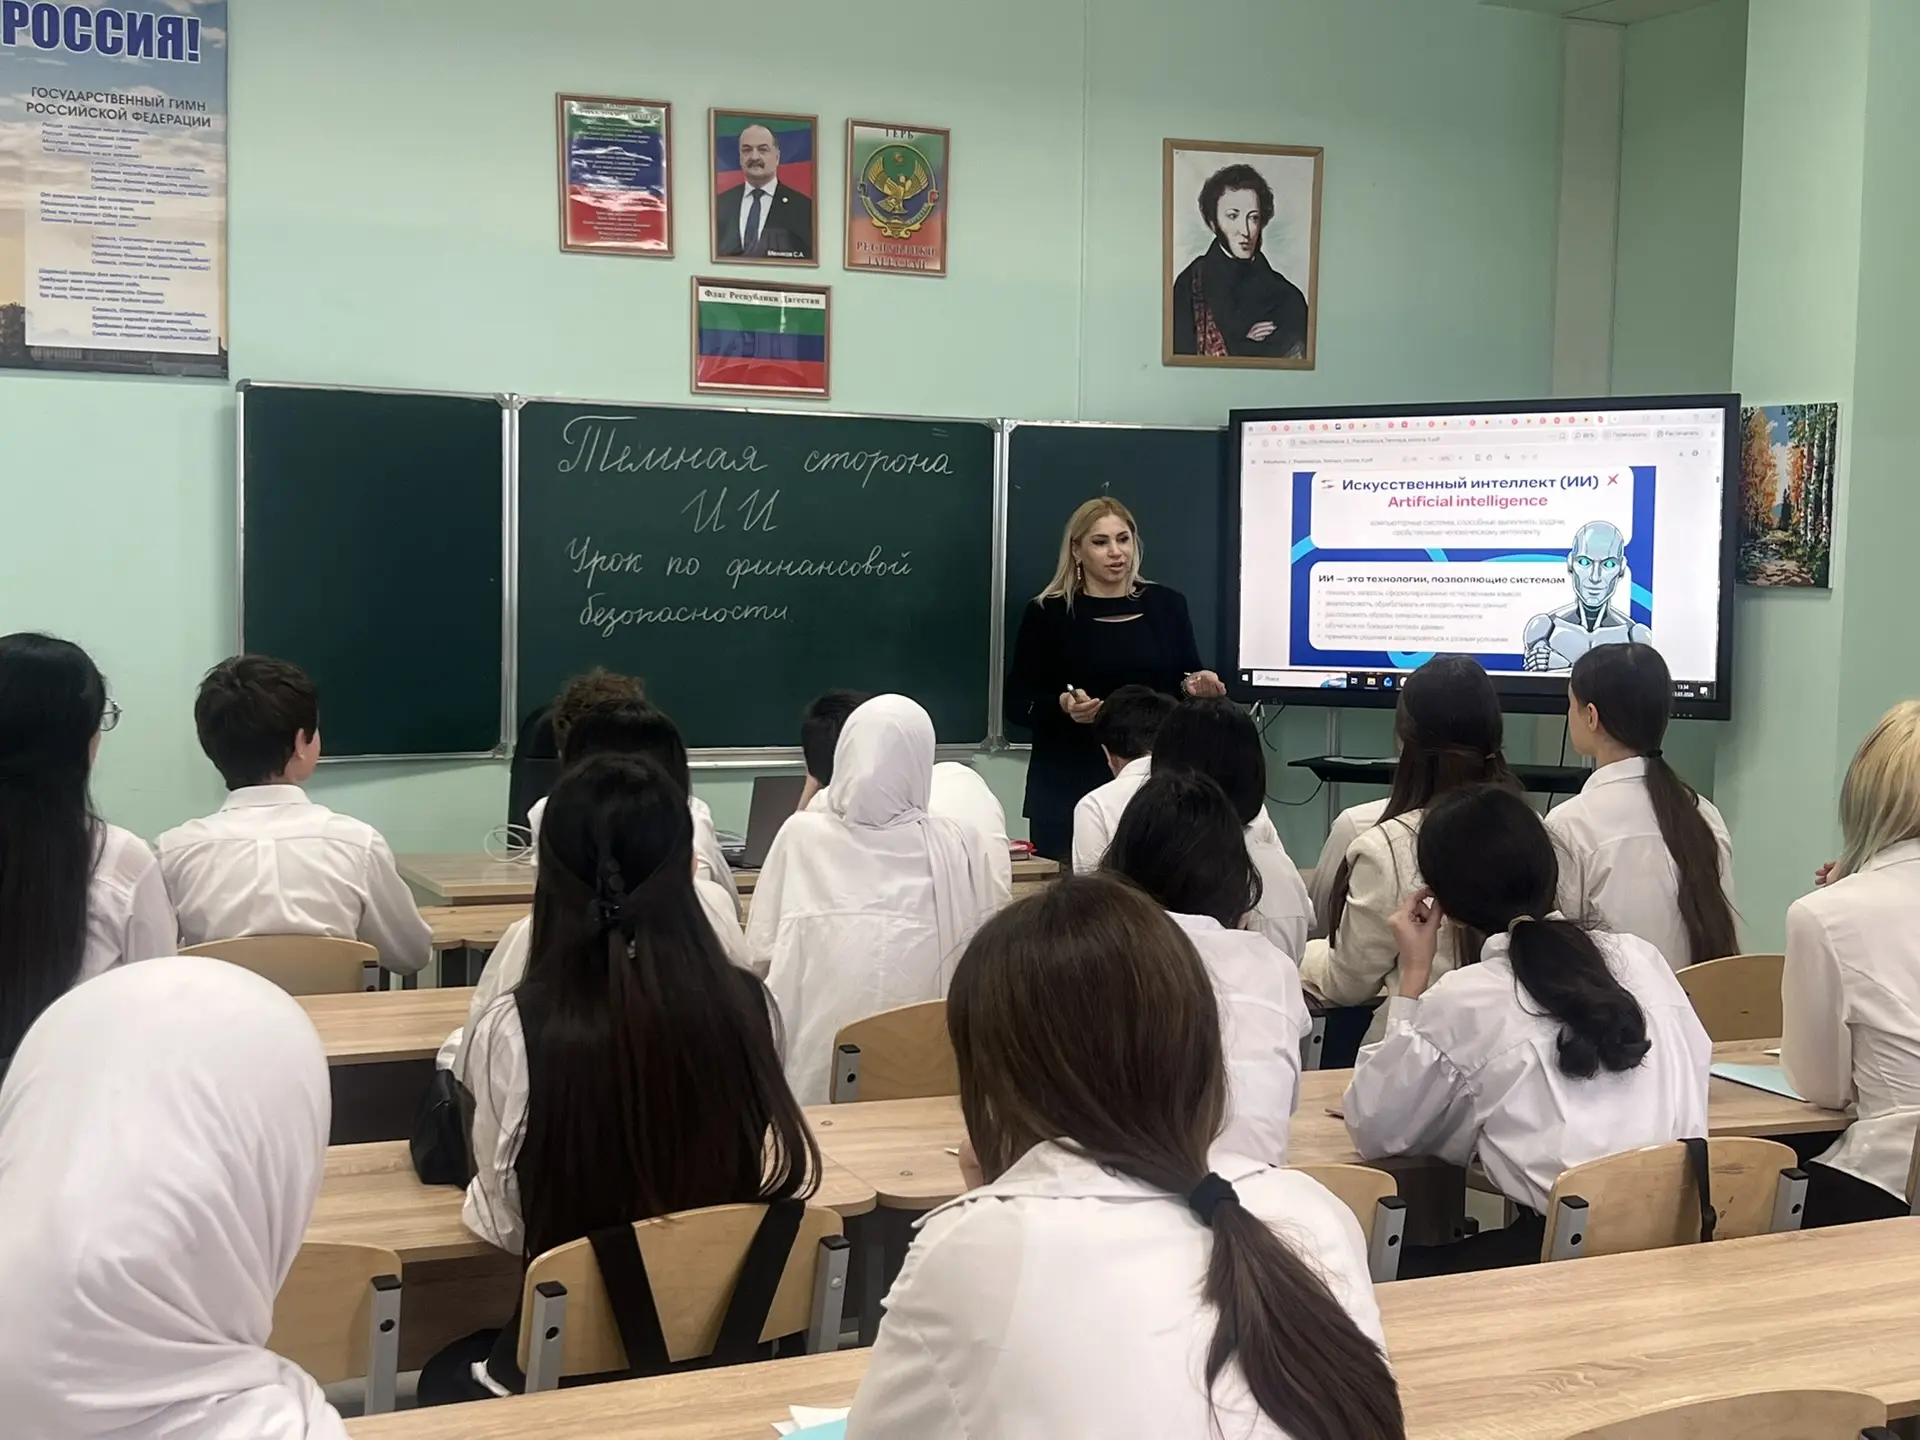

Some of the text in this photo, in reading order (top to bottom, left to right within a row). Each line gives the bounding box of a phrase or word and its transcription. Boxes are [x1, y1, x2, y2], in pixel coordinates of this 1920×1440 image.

[2, 0, 200, 63] РОССИЯ!
[31, 86, 206, 111] ГОСУДАРСТВЕННЫЙ ГИМН
[26, 102, 211, 128] РОССИЙСКОЙ ФЕДЕРАЦИИ
[704, 289, 726, 299] Флаг
[729, 291, 779, 303] Республики
[803, 449, 954, 489] сторона
[1341, 475, 1600, 492] Искусственный интеллект (ИИ)
[1388, 494, 1548, 509] Artificial intelligence
[566, 536, 913, 590] Урок по финансовой
[1318, 575, 1334, 583] ИИ
[1366, 576, 1430, 584] технологии,
[1431, 576, 1508, 584] позволяющие
[1509, 576, 1566, 584] системам
